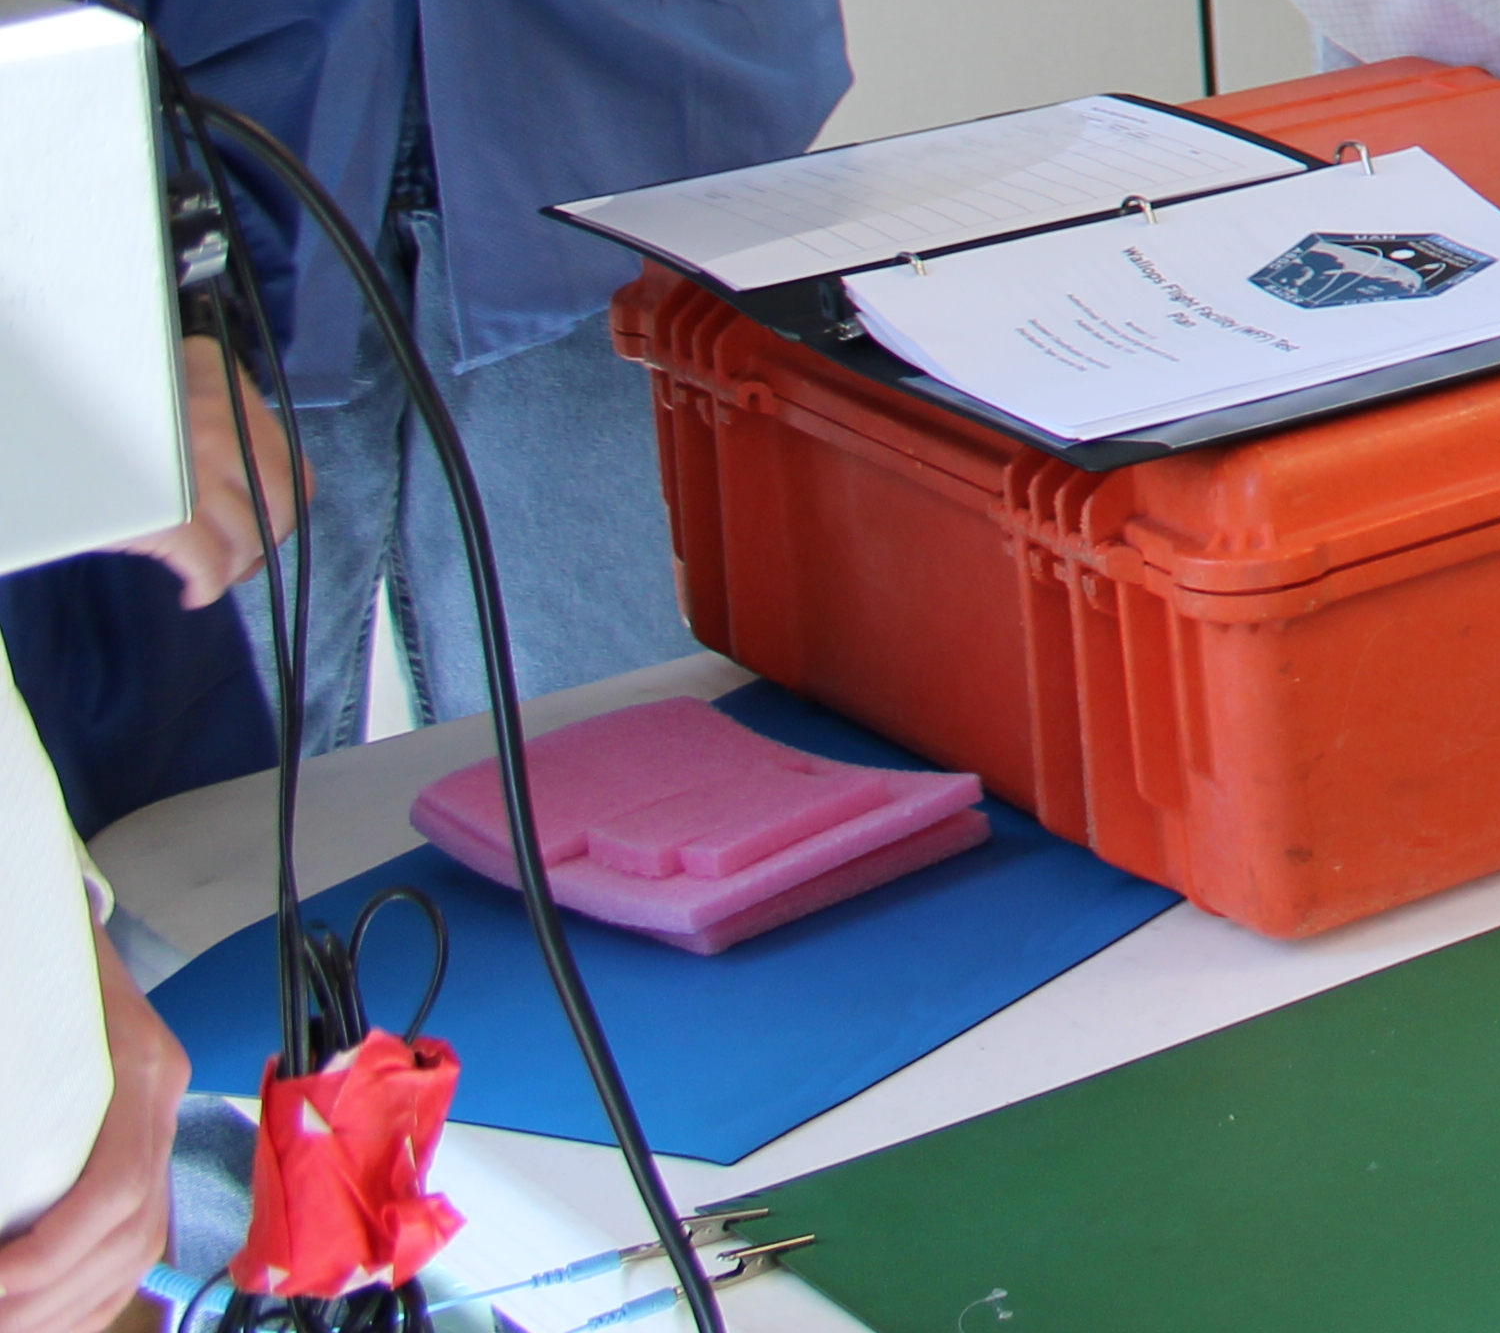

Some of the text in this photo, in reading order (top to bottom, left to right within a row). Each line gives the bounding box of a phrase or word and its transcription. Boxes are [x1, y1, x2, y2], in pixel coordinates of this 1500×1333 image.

[1121, 246, 1167, 284] Wallops
[1160, 283, 1200, 308] Flight
[1193, 306, 1240, 329] Facility
[1166, 311, 1197, 328] Plan
